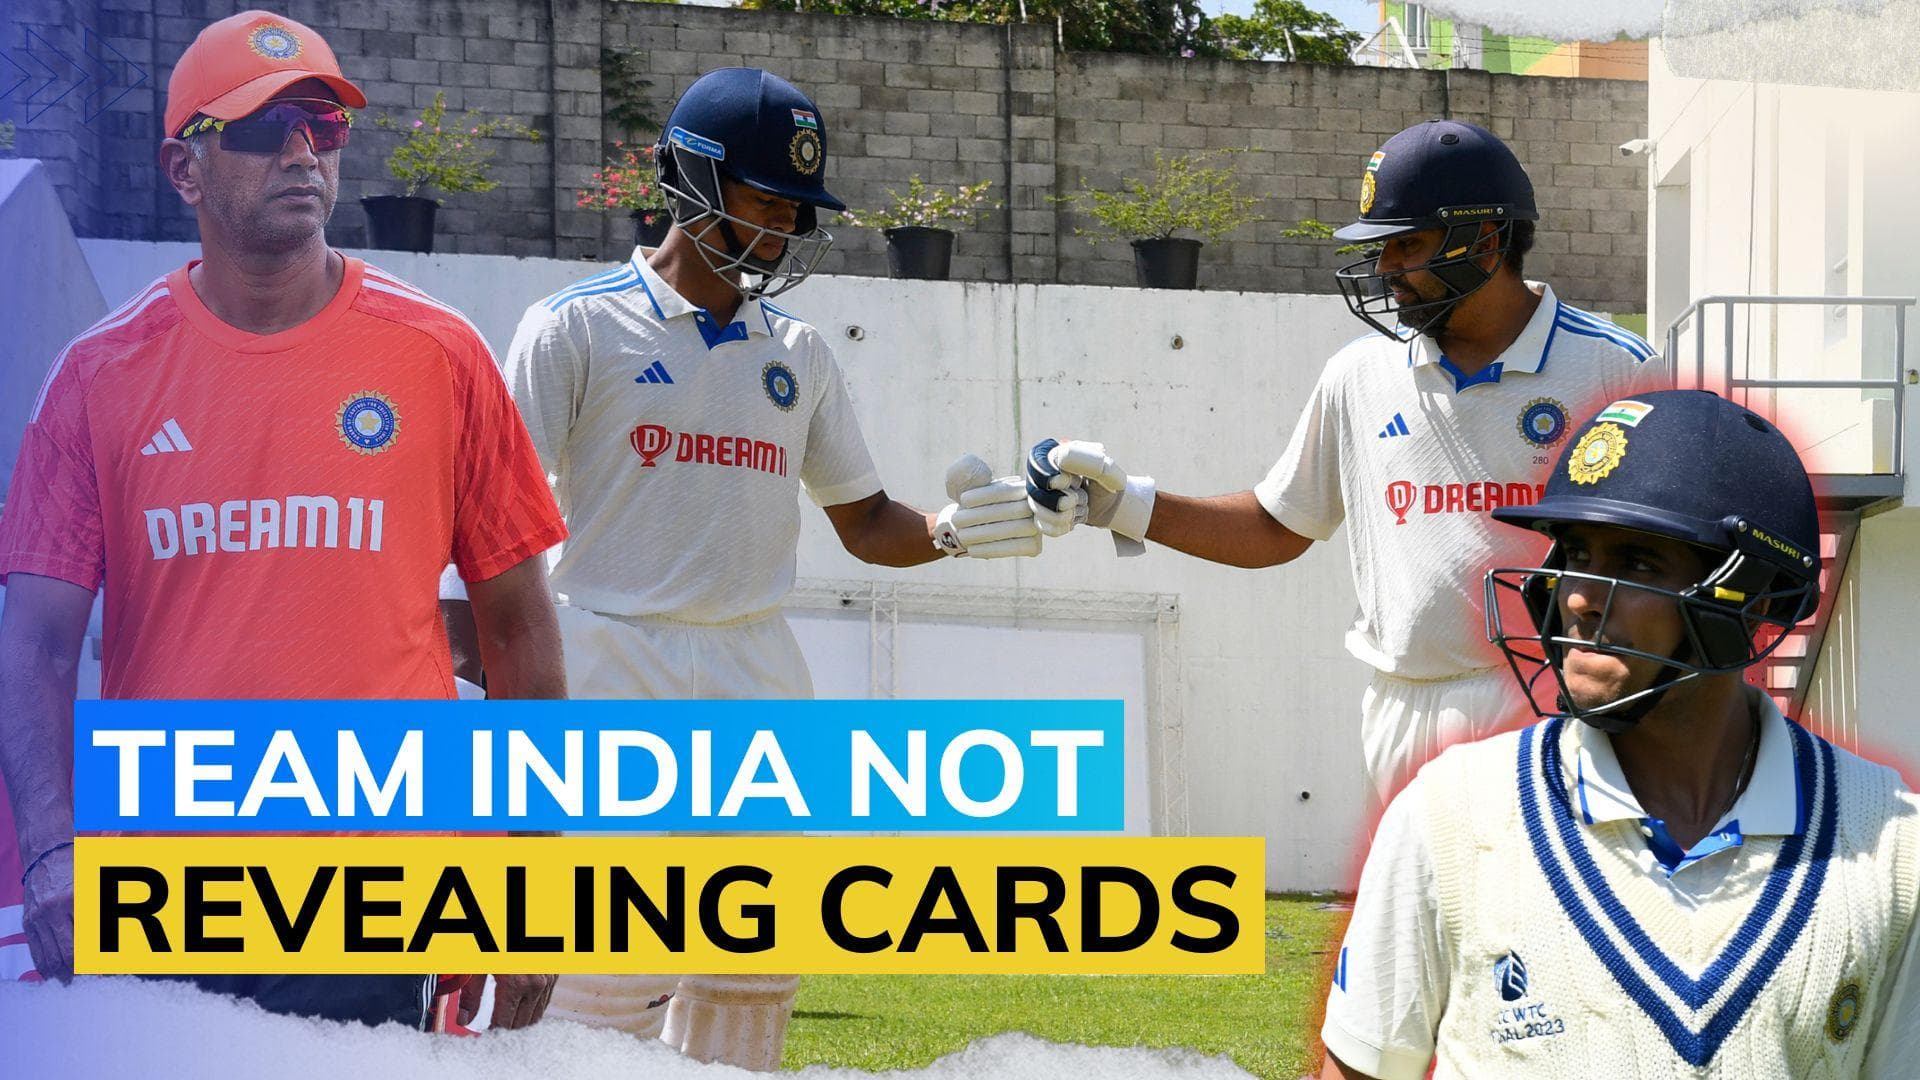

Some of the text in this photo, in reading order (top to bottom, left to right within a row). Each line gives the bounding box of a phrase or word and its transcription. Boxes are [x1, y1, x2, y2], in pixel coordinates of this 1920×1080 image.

[1453, 208, 1493, 216] MASURI
[1532, 456, 1549, 465] 280
[1423, 481, 1545, 514] DREAM1
[143, 495, 384, 560] DREAM11
[1752, 529, 1800, 560] MASURI
[1524, 1018, 1565, 1037] 2023
